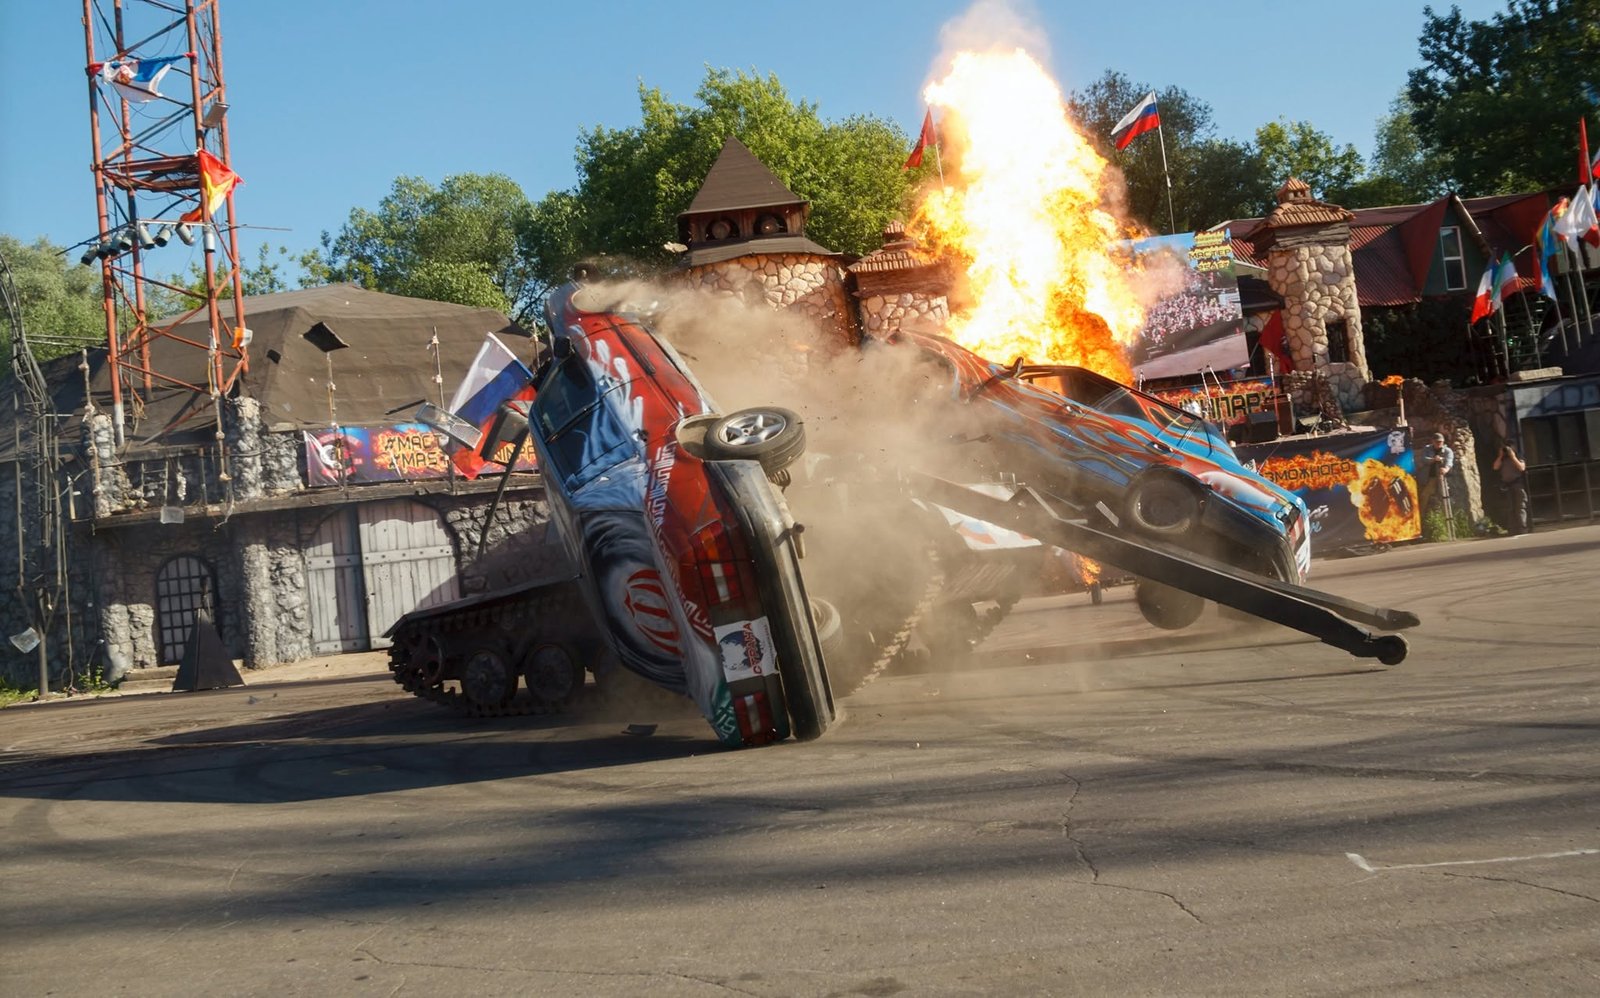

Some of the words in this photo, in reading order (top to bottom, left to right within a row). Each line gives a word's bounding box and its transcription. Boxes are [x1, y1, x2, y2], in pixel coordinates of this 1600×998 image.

[1188, 248, 1231, 258] МАСТЕР
[1261, 461, 1351, 482] ЗМОЖНОГО
[742, 622, 763, 674] СТРАНА
